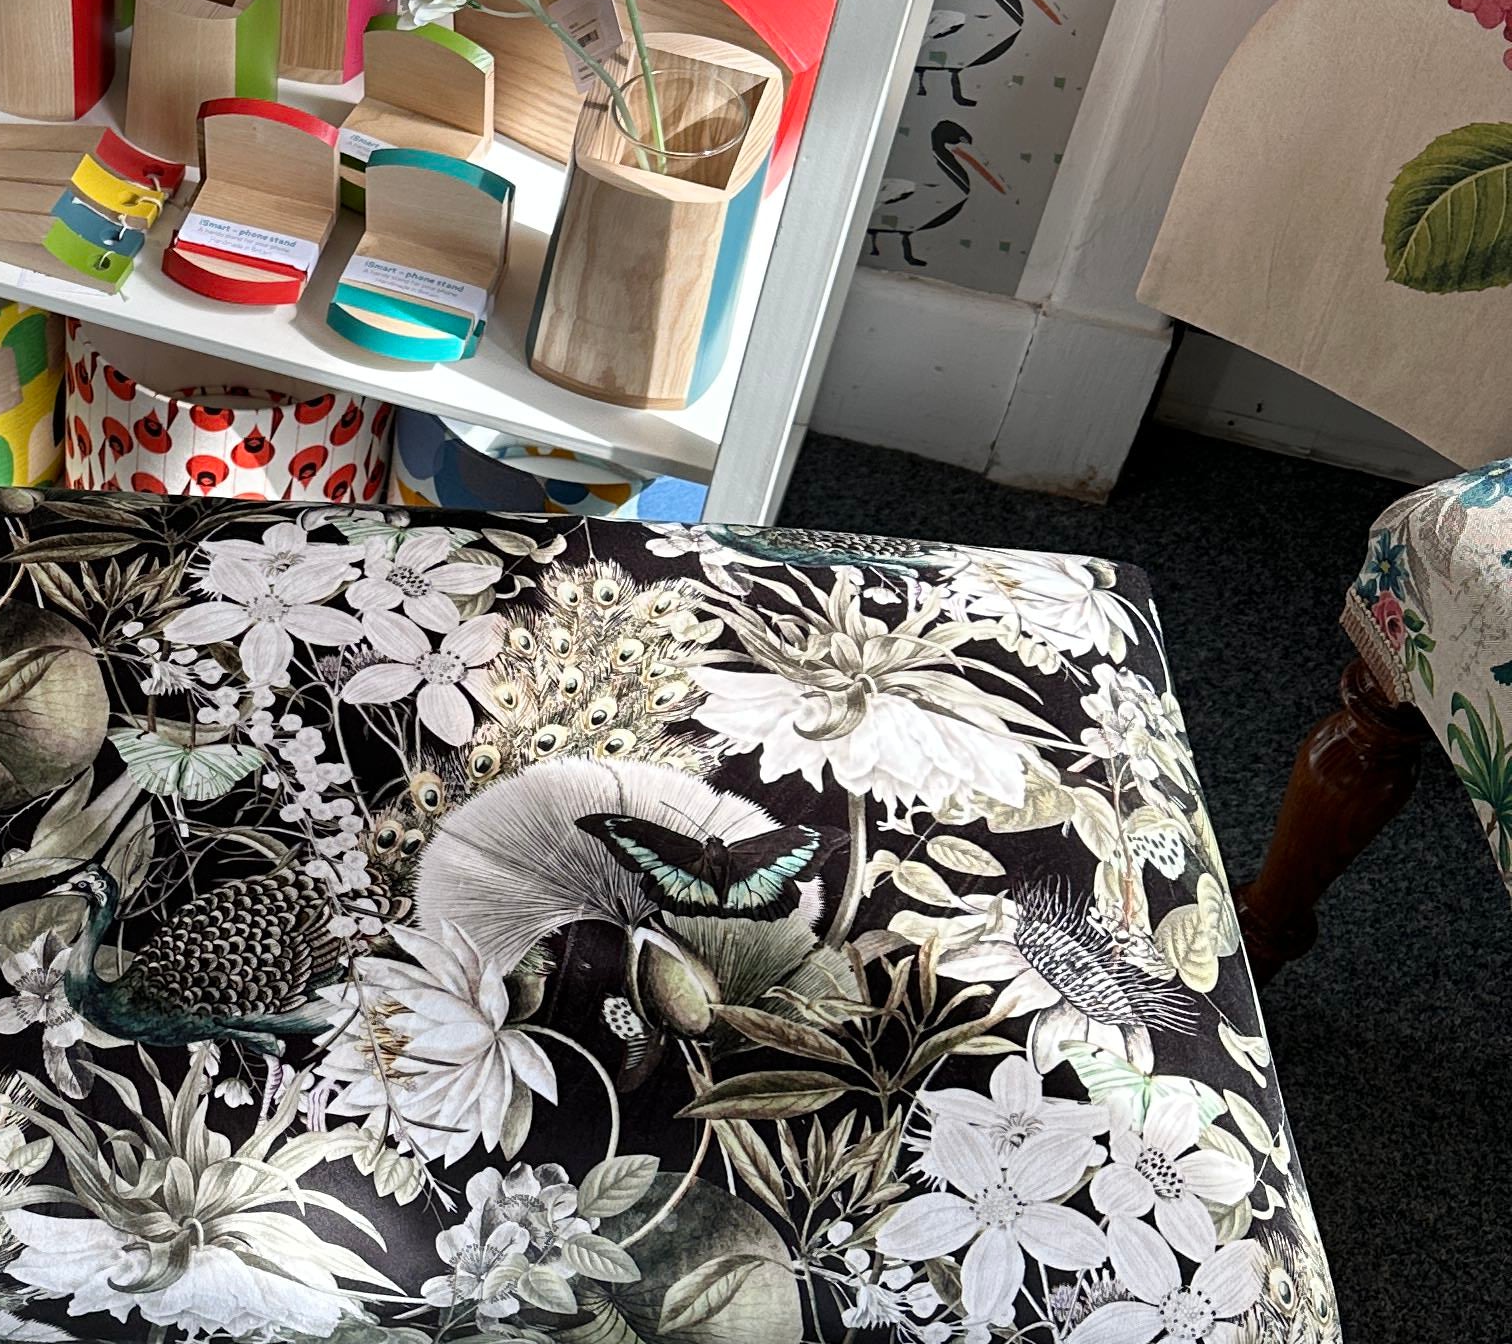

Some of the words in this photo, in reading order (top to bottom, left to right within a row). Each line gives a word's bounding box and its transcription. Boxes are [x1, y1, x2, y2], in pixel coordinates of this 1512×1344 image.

[238, 229, 268, 242] phone
[269, 236, 297, 248] stand
[404, 271, 435, 285] phone
[436, 279, 465, 293] stand
